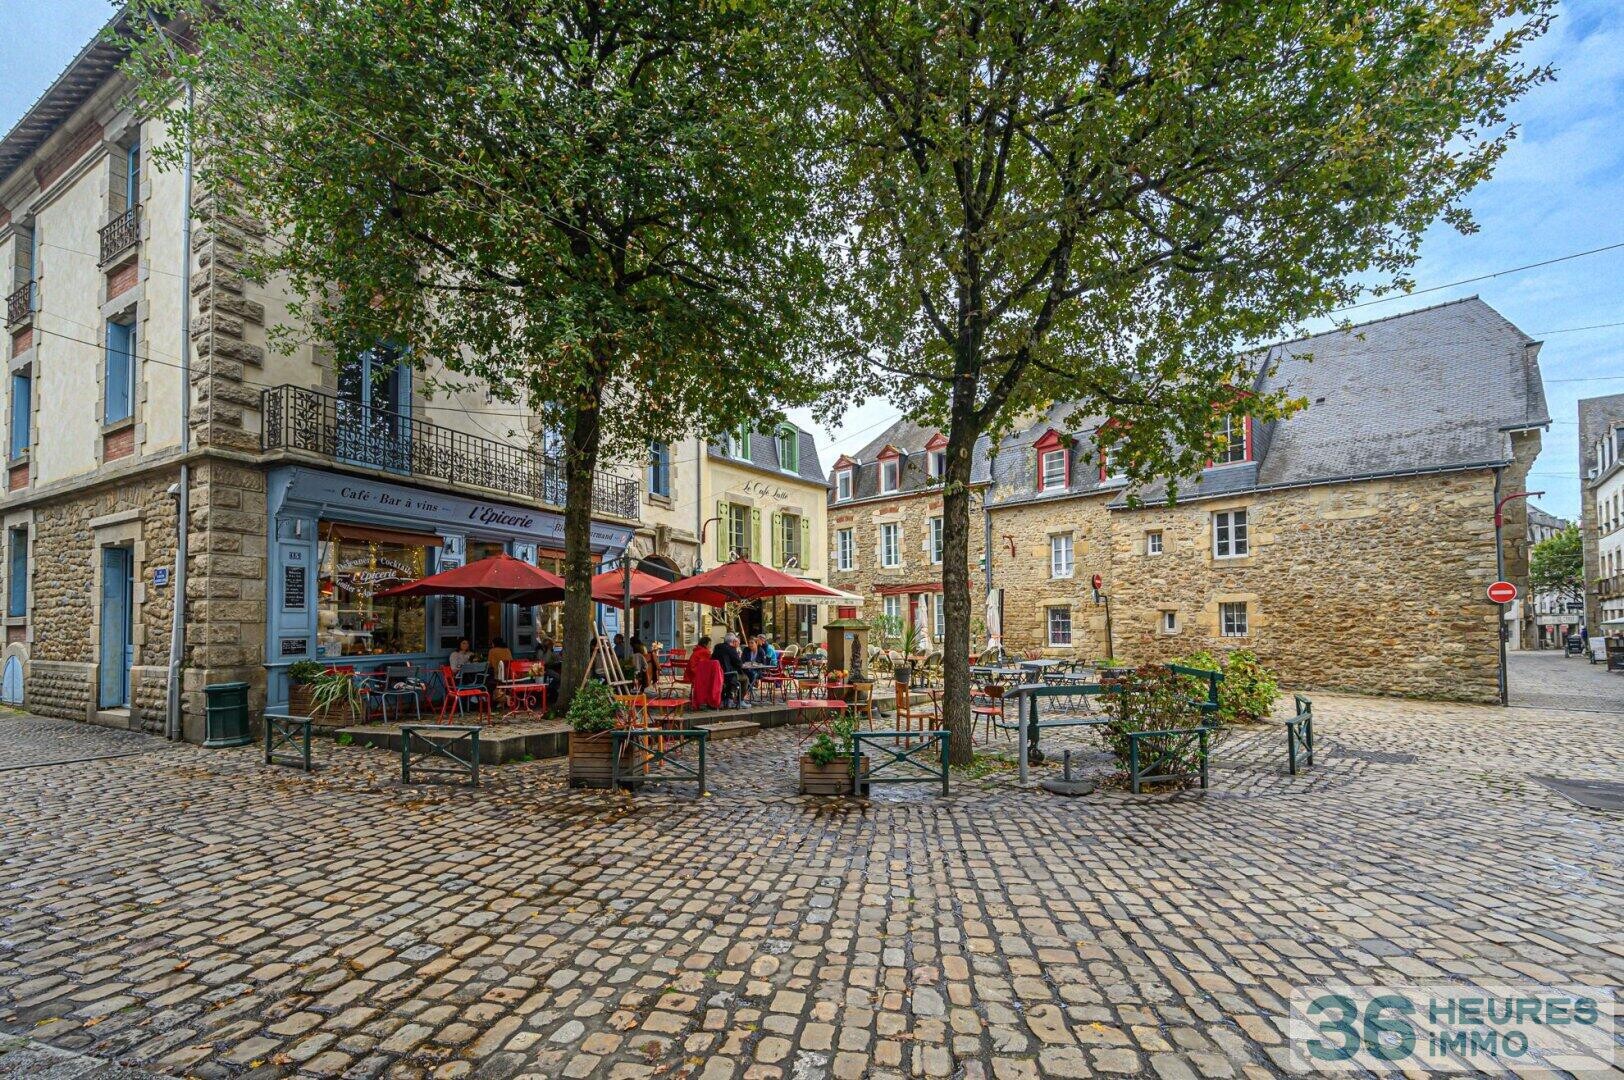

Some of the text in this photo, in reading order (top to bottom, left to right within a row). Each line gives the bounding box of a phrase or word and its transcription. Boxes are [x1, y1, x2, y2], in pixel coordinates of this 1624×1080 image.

[341, 487, 439, 512] Café Bar à vins
[380, 556, 413, 576] Cocktails
